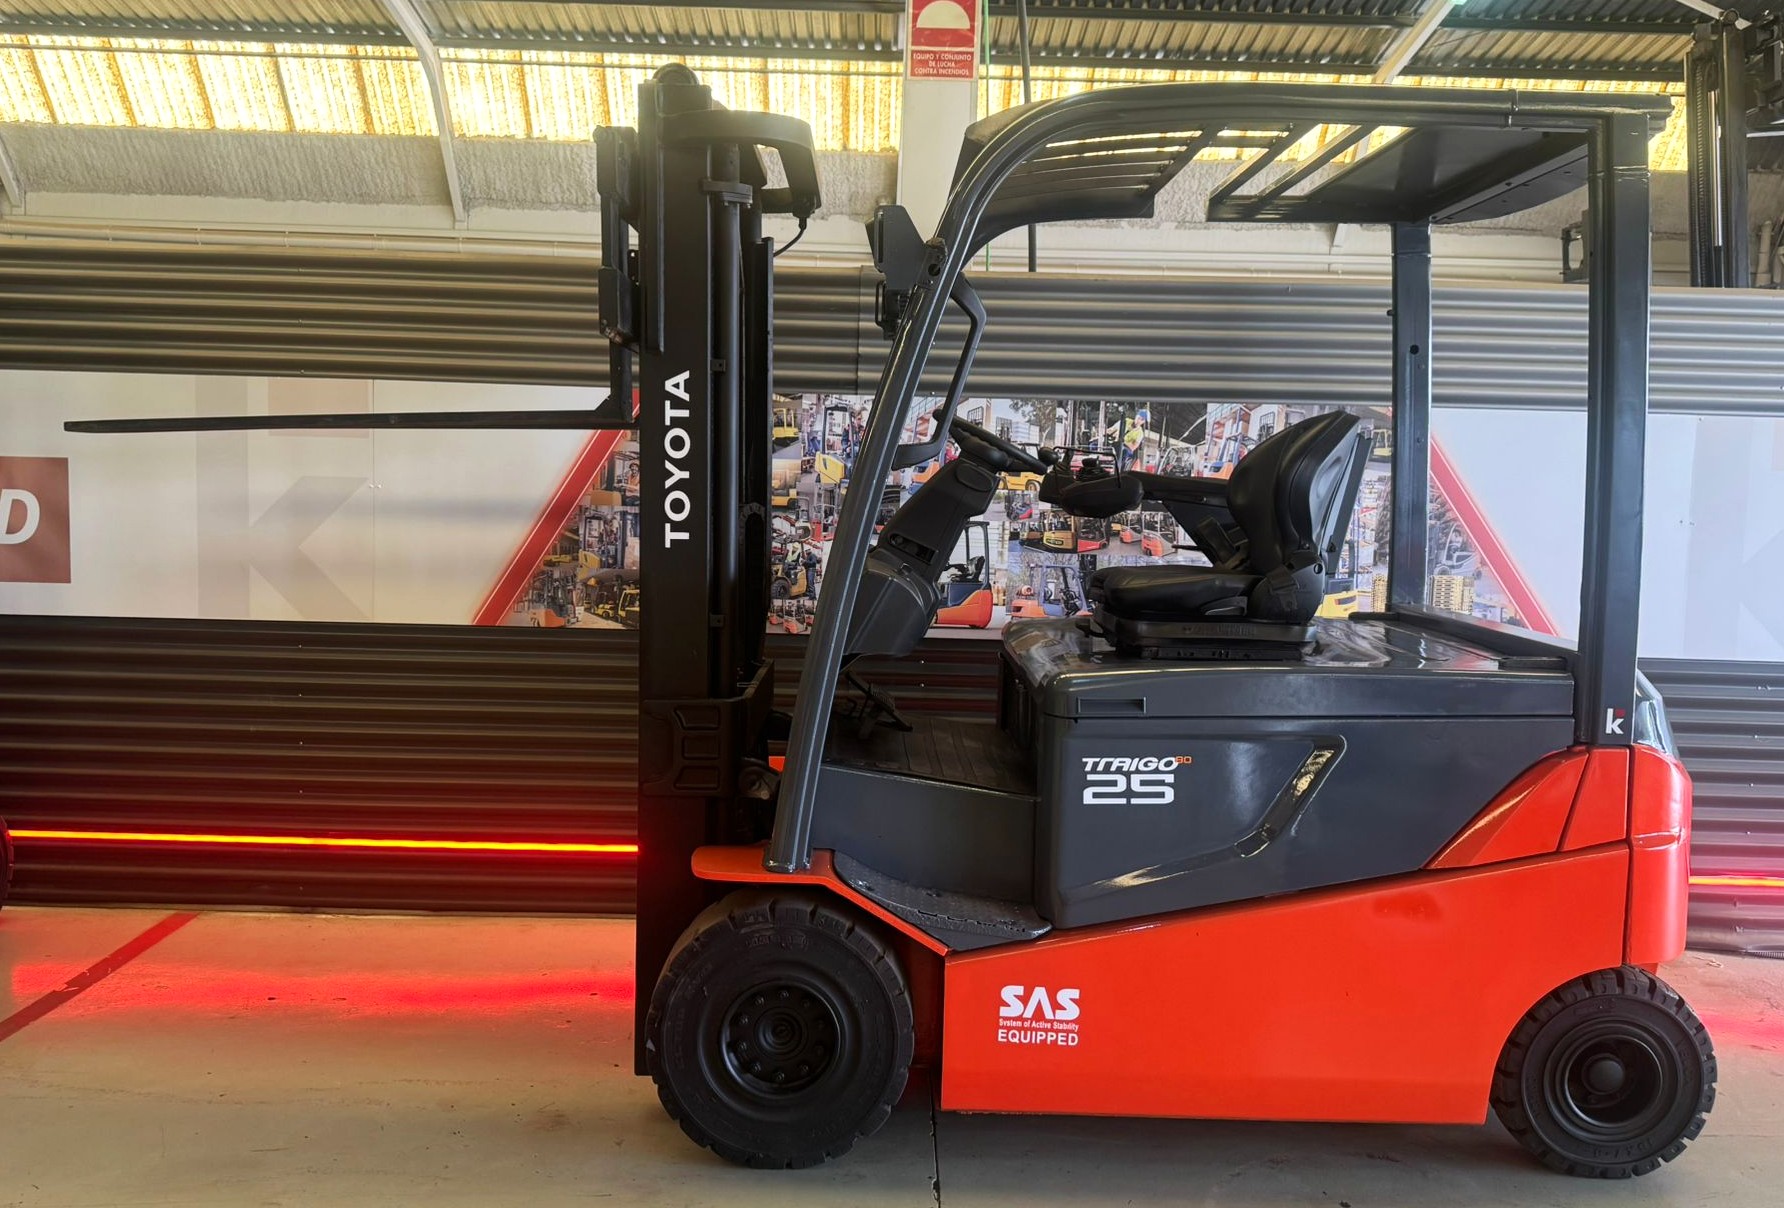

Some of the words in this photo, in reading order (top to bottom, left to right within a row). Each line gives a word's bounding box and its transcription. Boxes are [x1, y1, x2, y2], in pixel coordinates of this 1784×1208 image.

[941, 53, 972, 61] CONJUNTO
[664, 370, 691, 548] TOYOTA
[1083, 773, 1175, 804] 25
[999, 985, 1080, 1020] SAS
[998, 1029, 1079, 1046] EQUIPPED
[999, 1019, 1022, 1027] System
[1023, 1020, 1031, 1028] of
[1031, 1020, 1051, 1029] Active
[1052, 1021, 1079, 1032] Stability
